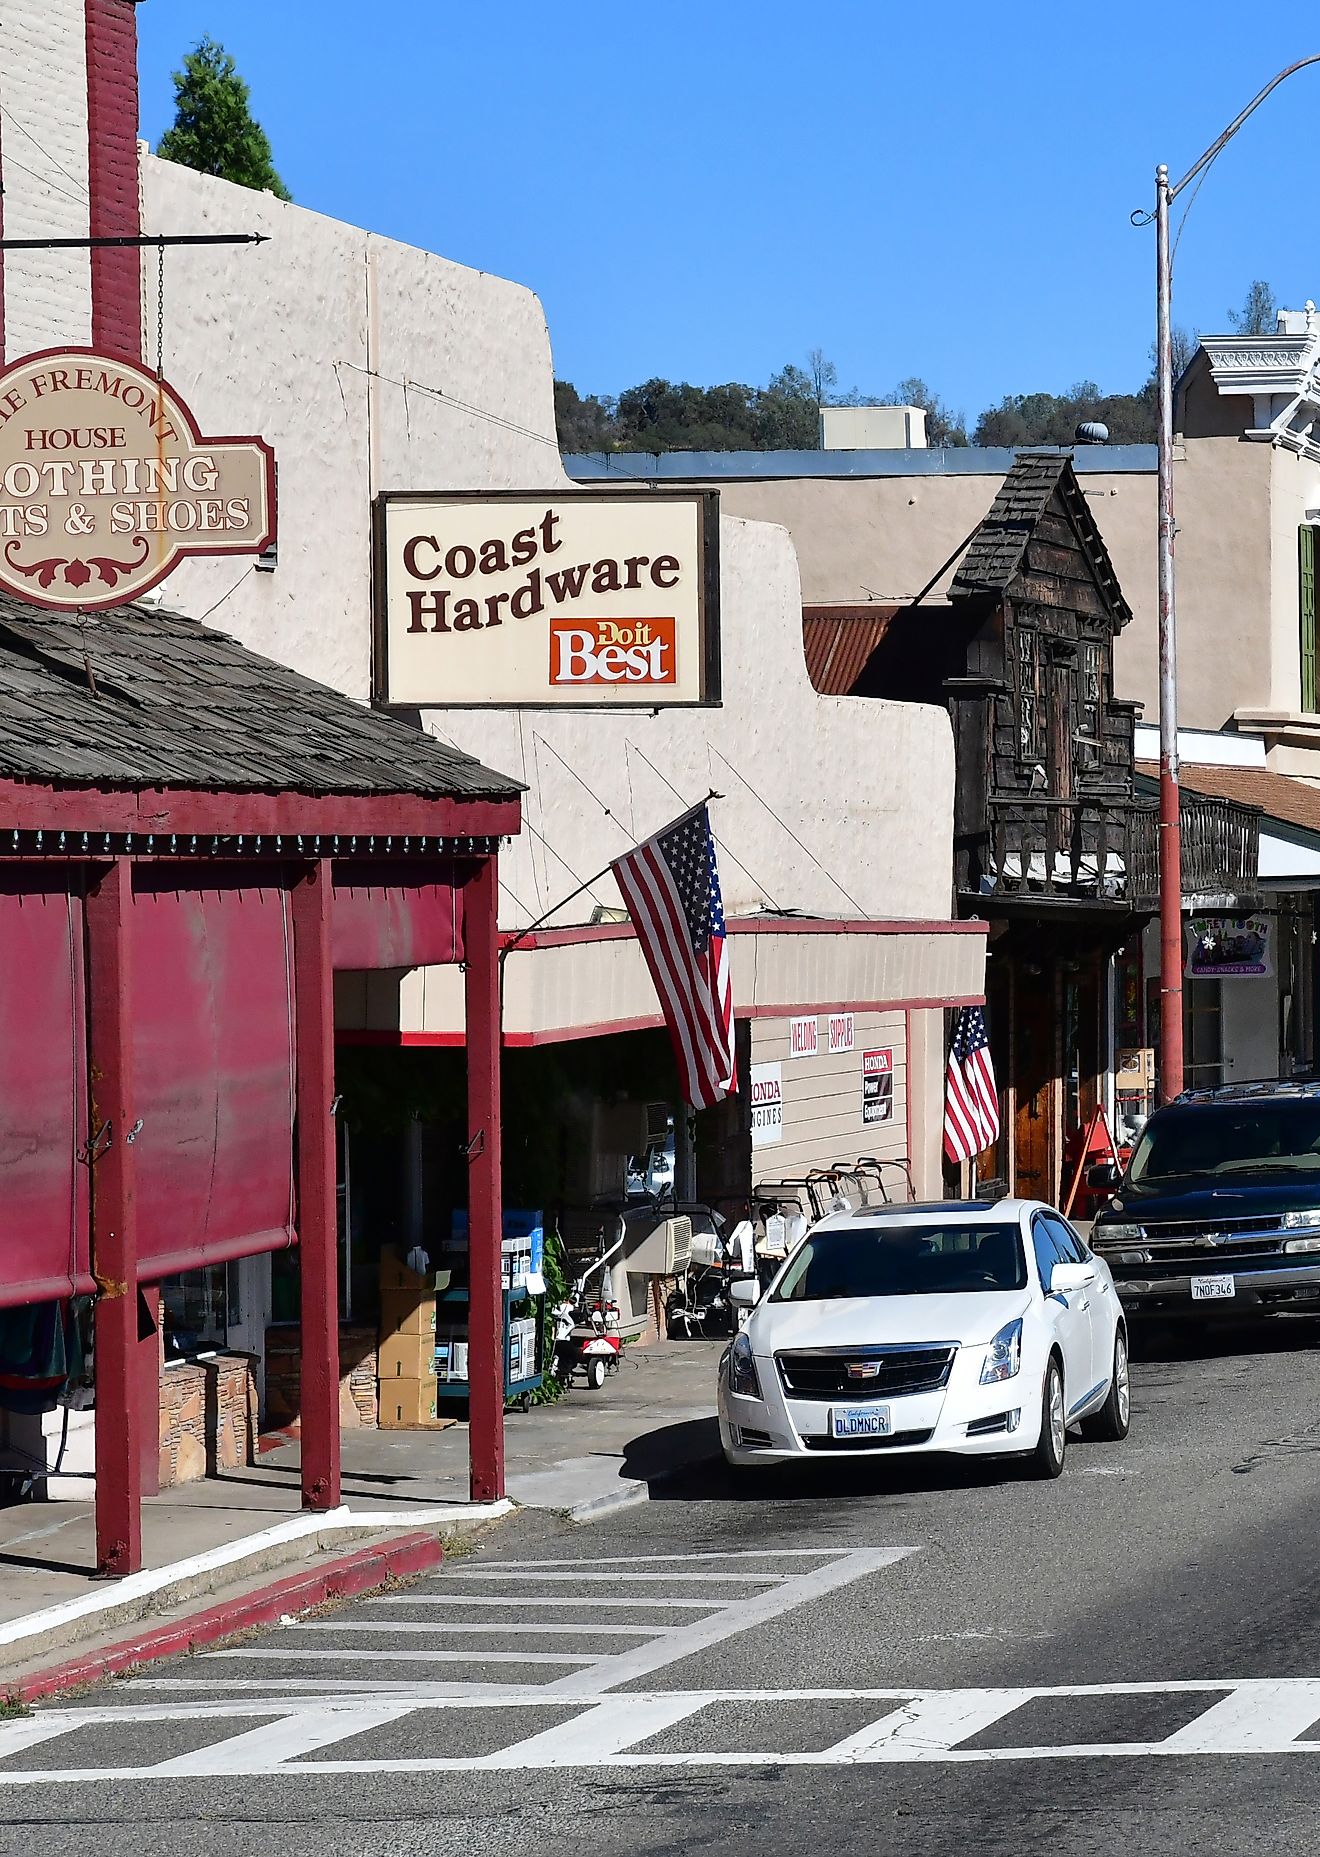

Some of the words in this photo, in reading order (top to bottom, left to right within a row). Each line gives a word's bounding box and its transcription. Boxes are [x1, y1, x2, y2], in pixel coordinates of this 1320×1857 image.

[29, 368, 179, 444] FREMONT
[24, 427, 127, 450] HOUSE
[0, 456, 219, 498] OTHING
[64, 503, 95, 535] &
[111, 498, 250, 534] SHOES
[403, 508, 563, 581] Coast
[406, 554, 681, 634] Hardware
[553, 629, 669, 682] Best
[864, 1055, 888, 1071] HONDA
[864, 1080, 879, 1095] Power
